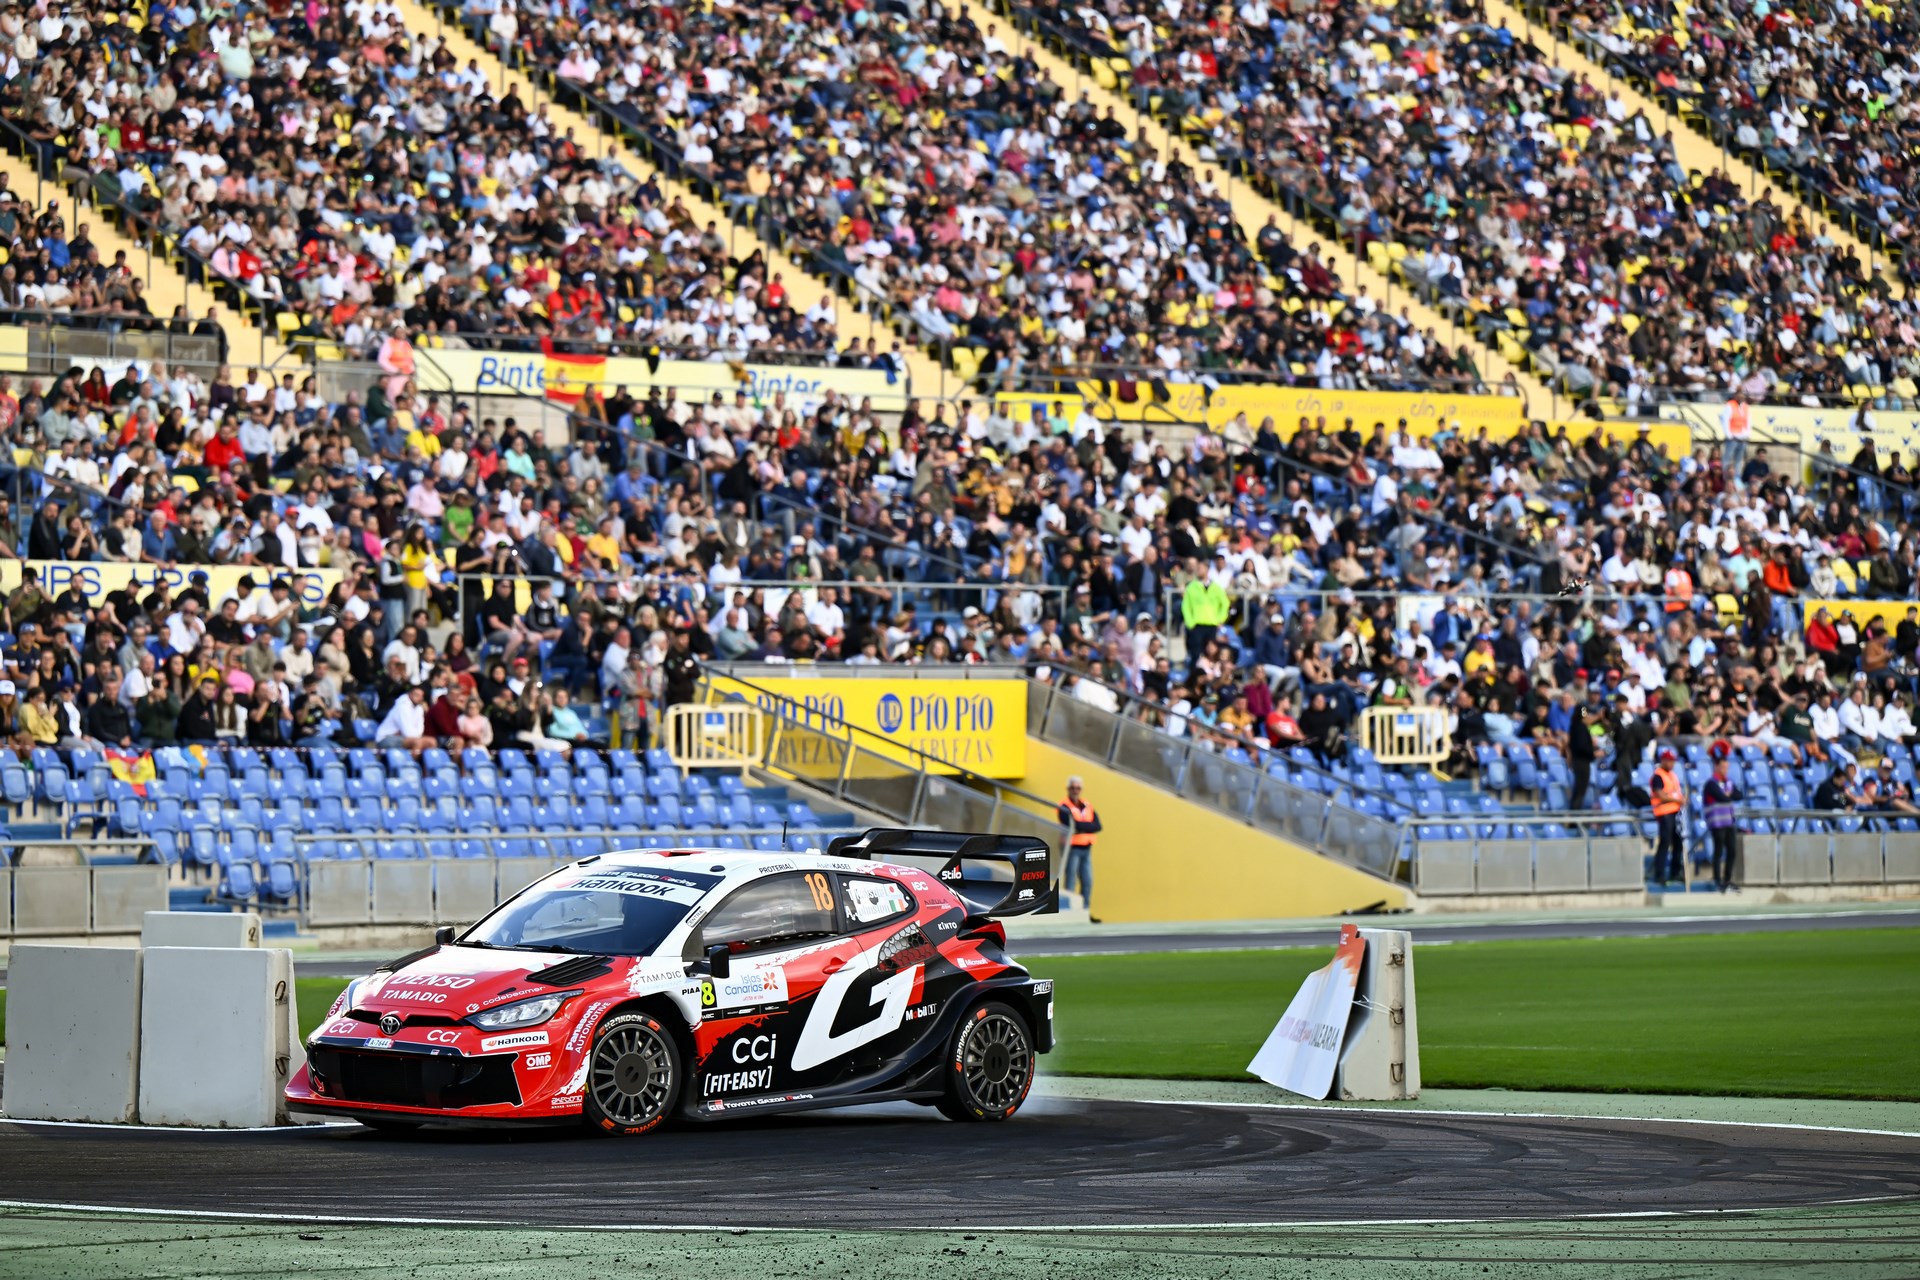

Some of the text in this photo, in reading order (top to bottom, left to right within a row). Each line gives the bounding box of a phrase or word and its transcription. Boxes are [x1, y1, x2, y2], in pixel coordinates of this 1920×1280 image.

[479, 357, 545, 389] Binte
[758, 863, 794, 875] PROTERIAL
[941, 865, 962, 880] Stilo
[1021, 870, 1046, 881] DENSO
[804, 872, 835, 912] 18
[390, 974, 476, 989] DENSO
[640, 970, 682, 984] TAMADIC
[740, 974, 762, 985] Islas
[482, 986, 546, 1006] codebeamer
[682, 987, 700, 995] PIAA
[725, 982, 764, 996] Canarias
[382, 990, 448, 1004] TAMADIC
[905, 1006, 928, 1021] Mobil
[565, 1001, 602, 1052] Panasonic
[574, 1002, 612, 1054] AUTOMOTIVE
[526, 1054, 552, 1067] OMP
[725, 1100, 758, 1110] TOYOTA
[757, 1096, 786, 1105] GAZOO
[785, 1093, 814, 1103] Racing
